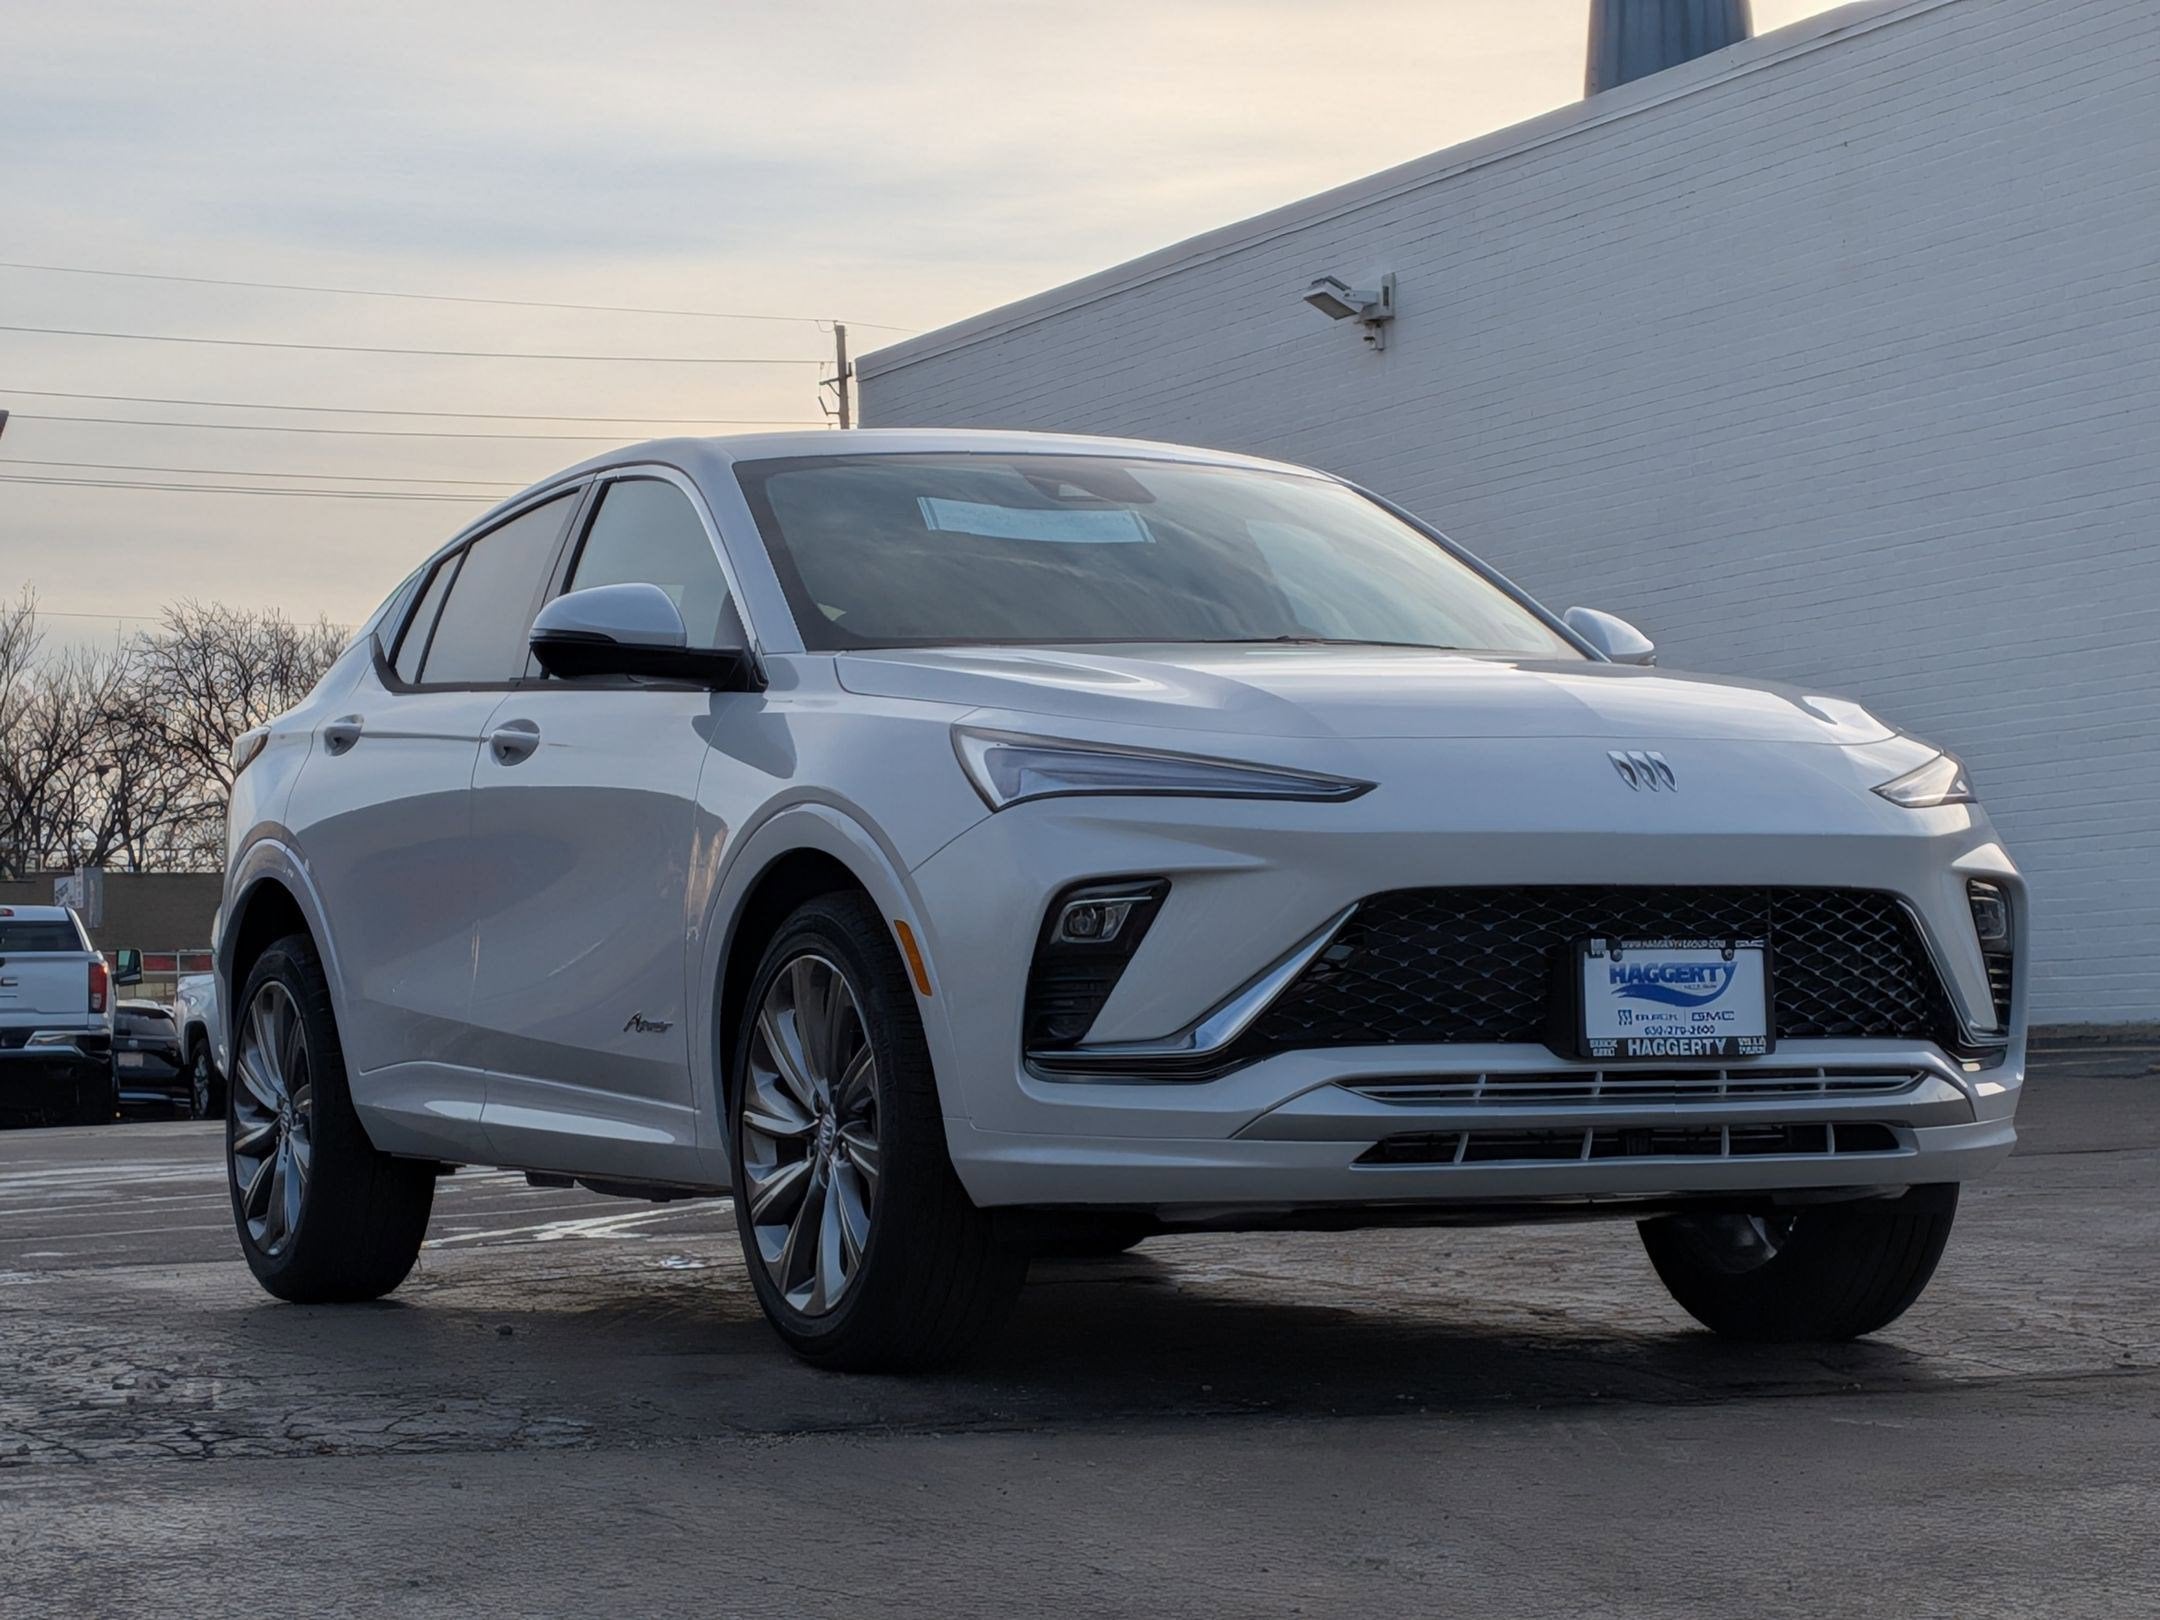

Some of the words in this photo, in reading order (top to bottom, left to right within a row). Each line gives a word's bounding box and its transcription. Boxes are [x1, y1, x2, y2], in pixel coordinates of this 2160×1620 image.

[1609, 961, 1739, 985] HAGGERTY
[1691, 1011, 1735, 1021] GMC
[1627, 1038, 1727, 1057] HAGGERTY
